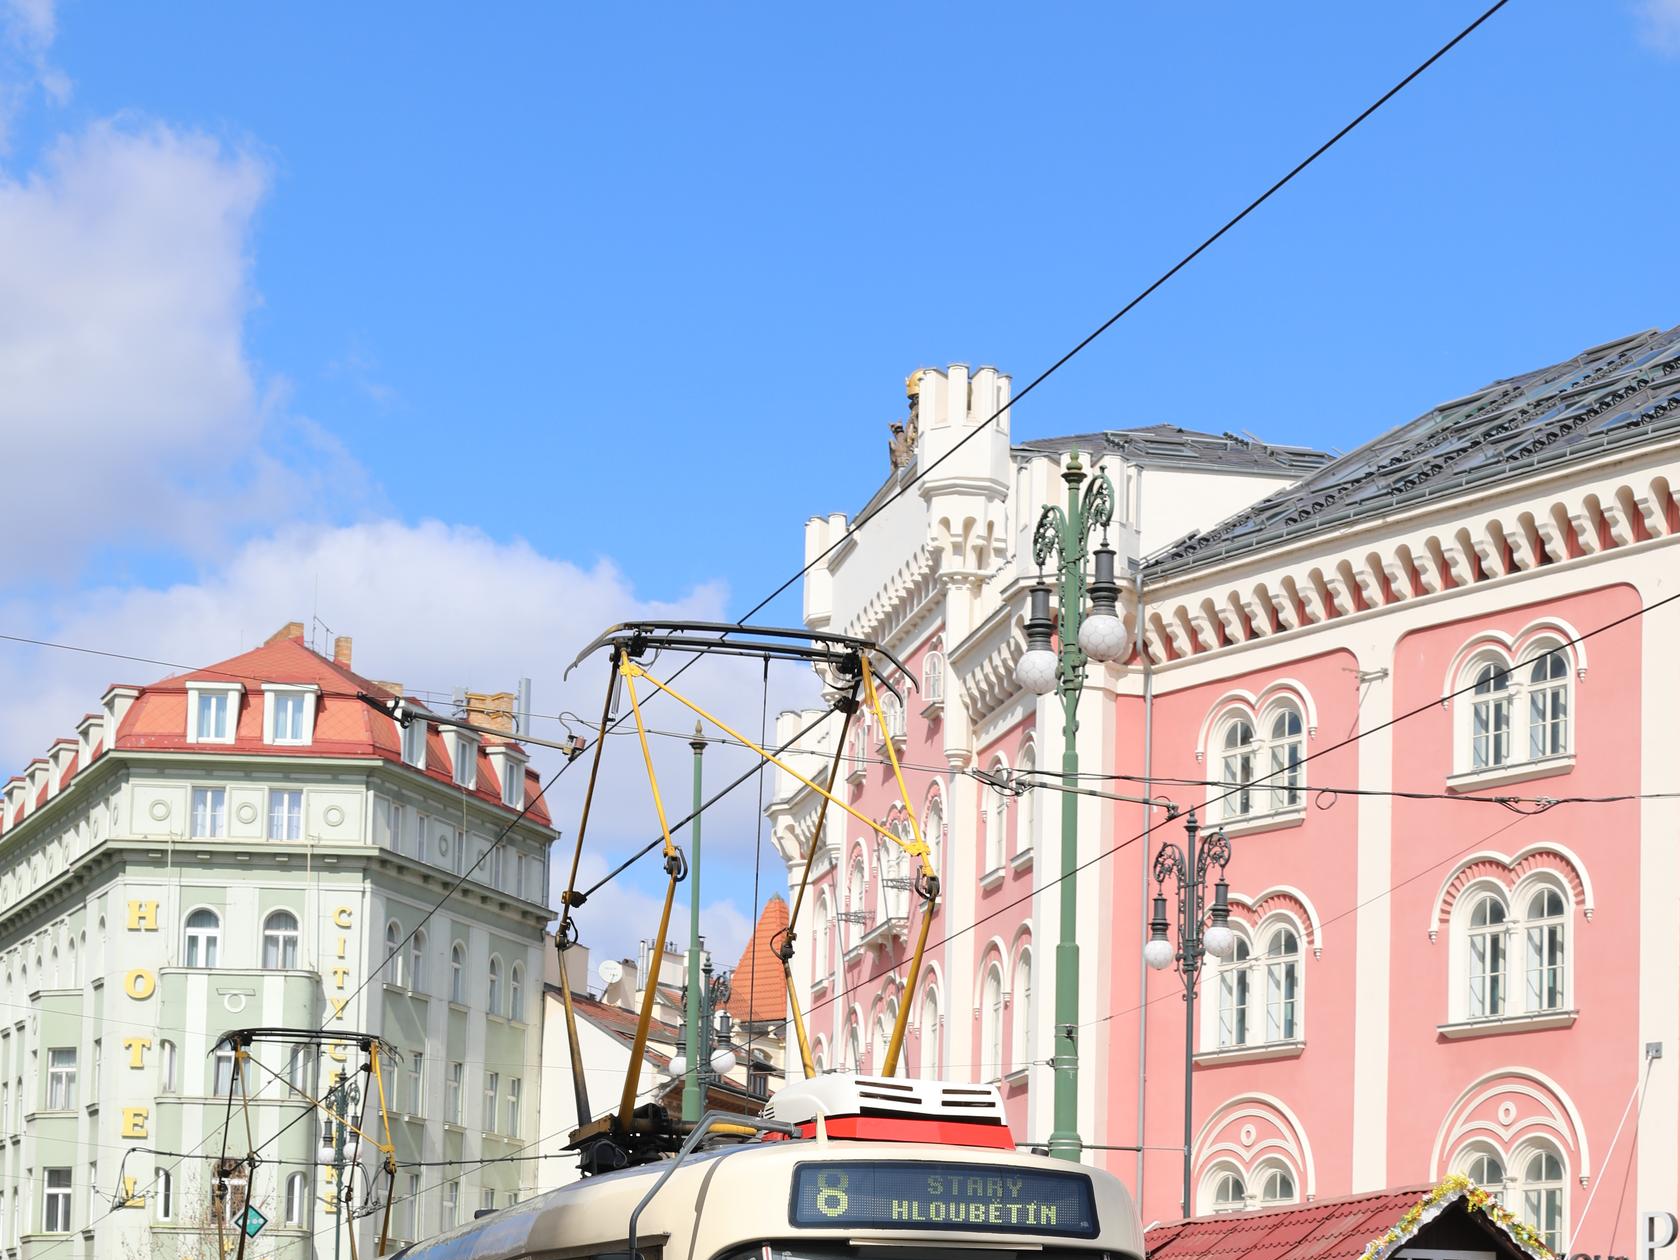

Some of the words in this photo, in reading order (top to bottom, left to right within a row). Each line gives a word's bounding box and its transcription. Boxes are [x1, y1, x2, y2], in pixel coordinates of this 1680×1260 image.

[331, 905, 353, 1021] CITY
[122, 900, 160, 1208] HOTEL
[816, 1168, 849, 1217] 8
[892, 1199, 1057, 1226] HLOUBĚTÍN
